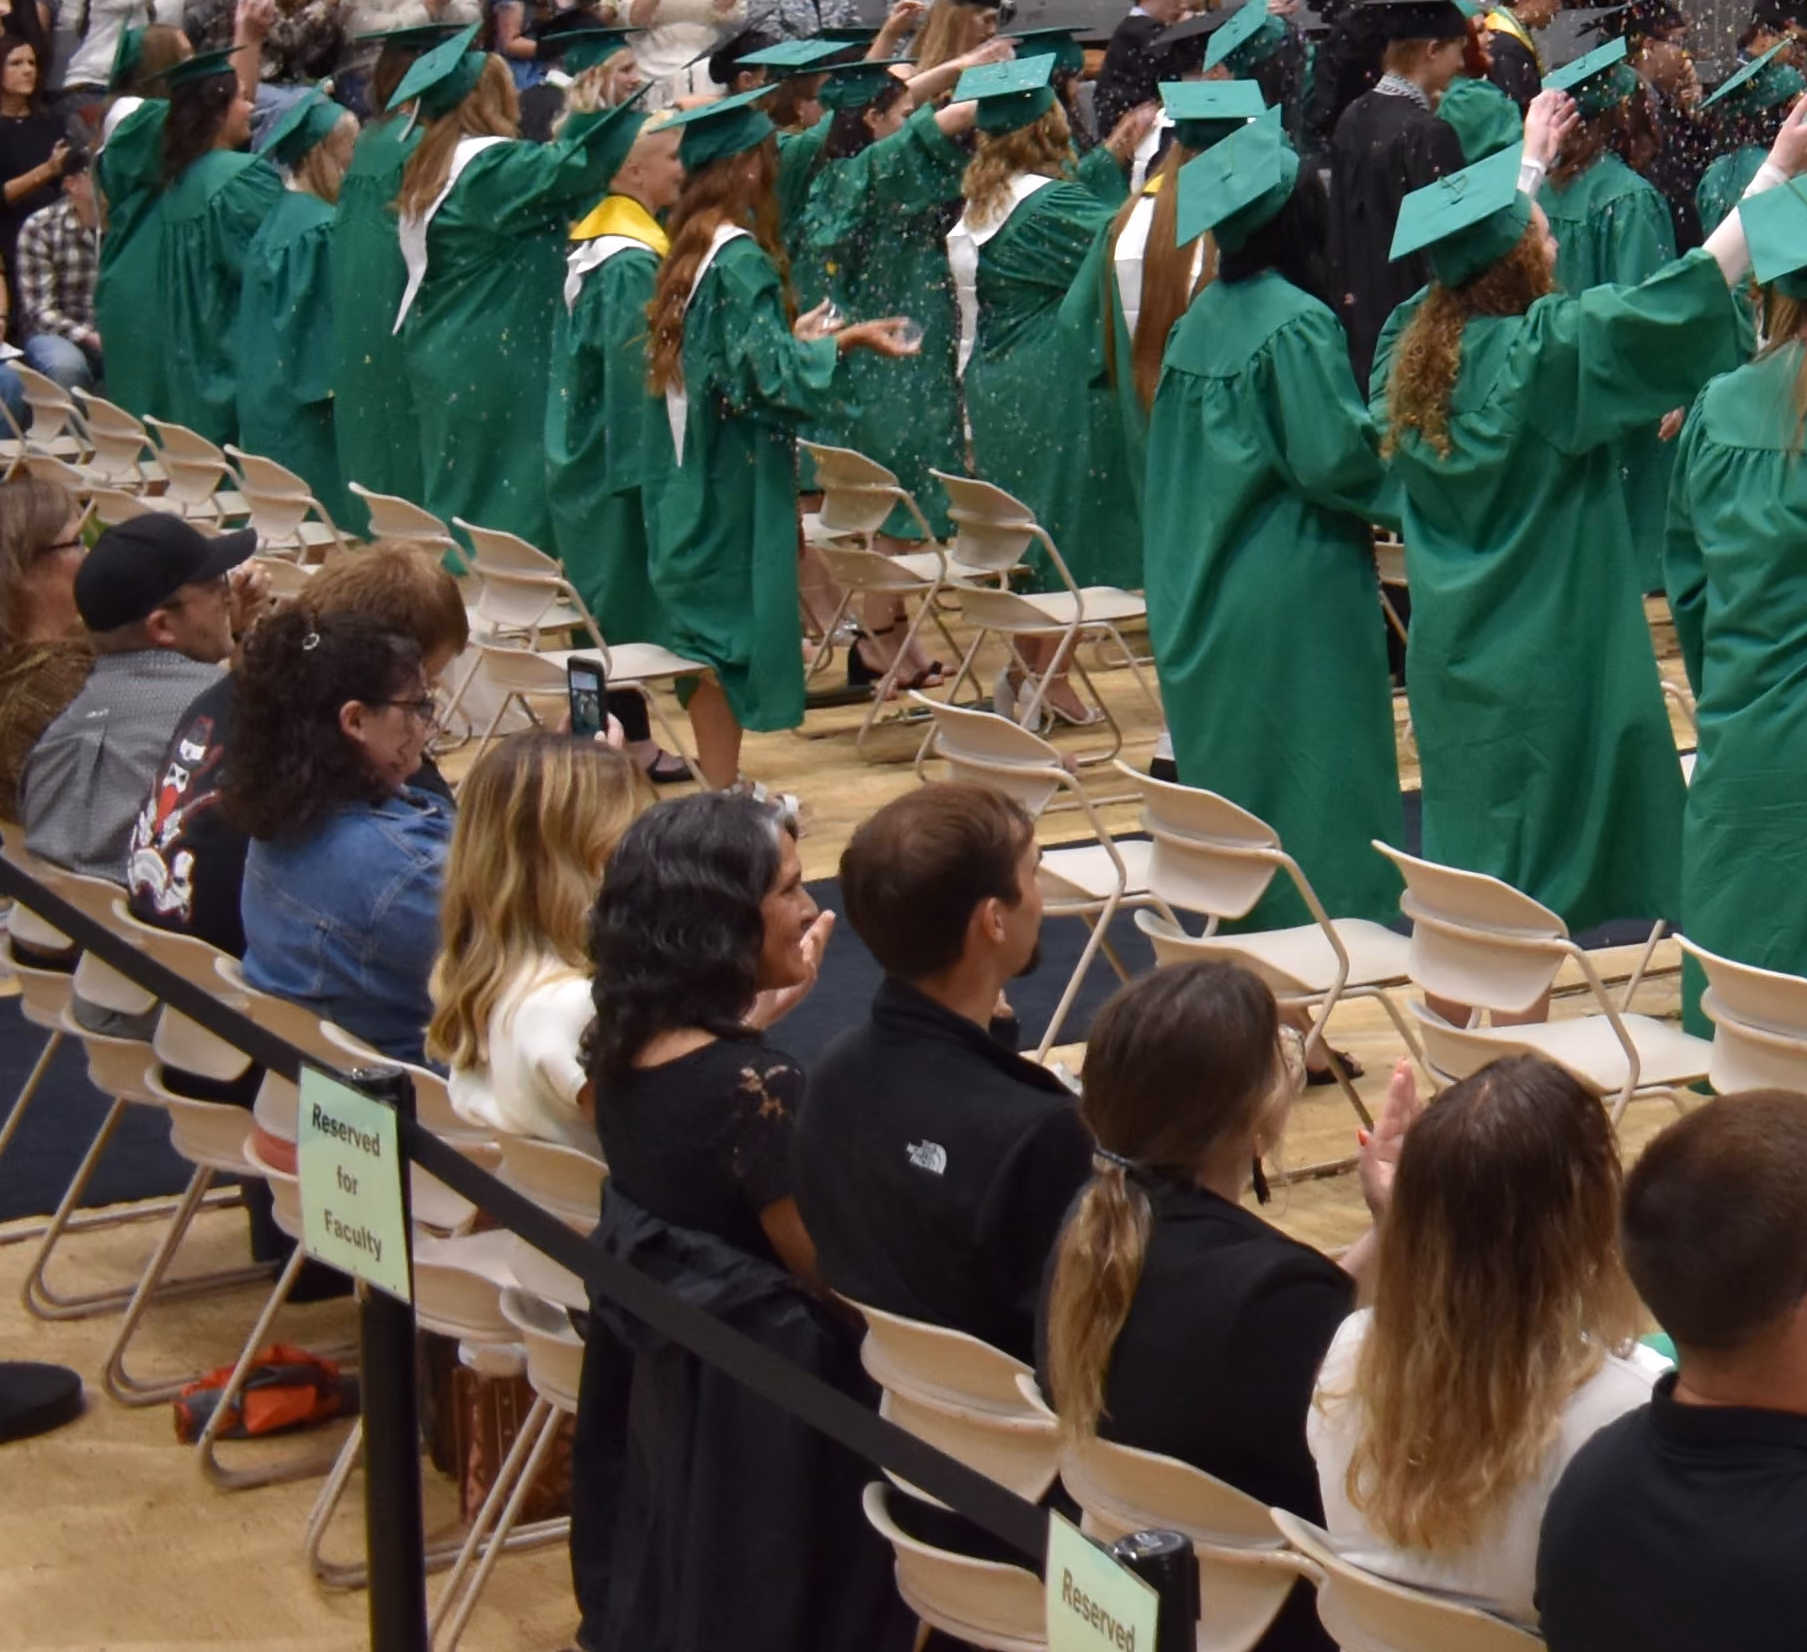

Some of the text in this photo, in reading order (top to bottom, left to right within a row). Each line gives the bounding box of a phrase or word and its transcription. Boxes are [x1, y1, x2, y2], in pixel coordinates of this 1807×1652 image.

[312, 1102, 381, 1157] Reserved
[337, 1165, 358, 1196] for
[324, 1208, 382, 1262] Faculty
[1062, 1567, 1136, 1652] Reserved
